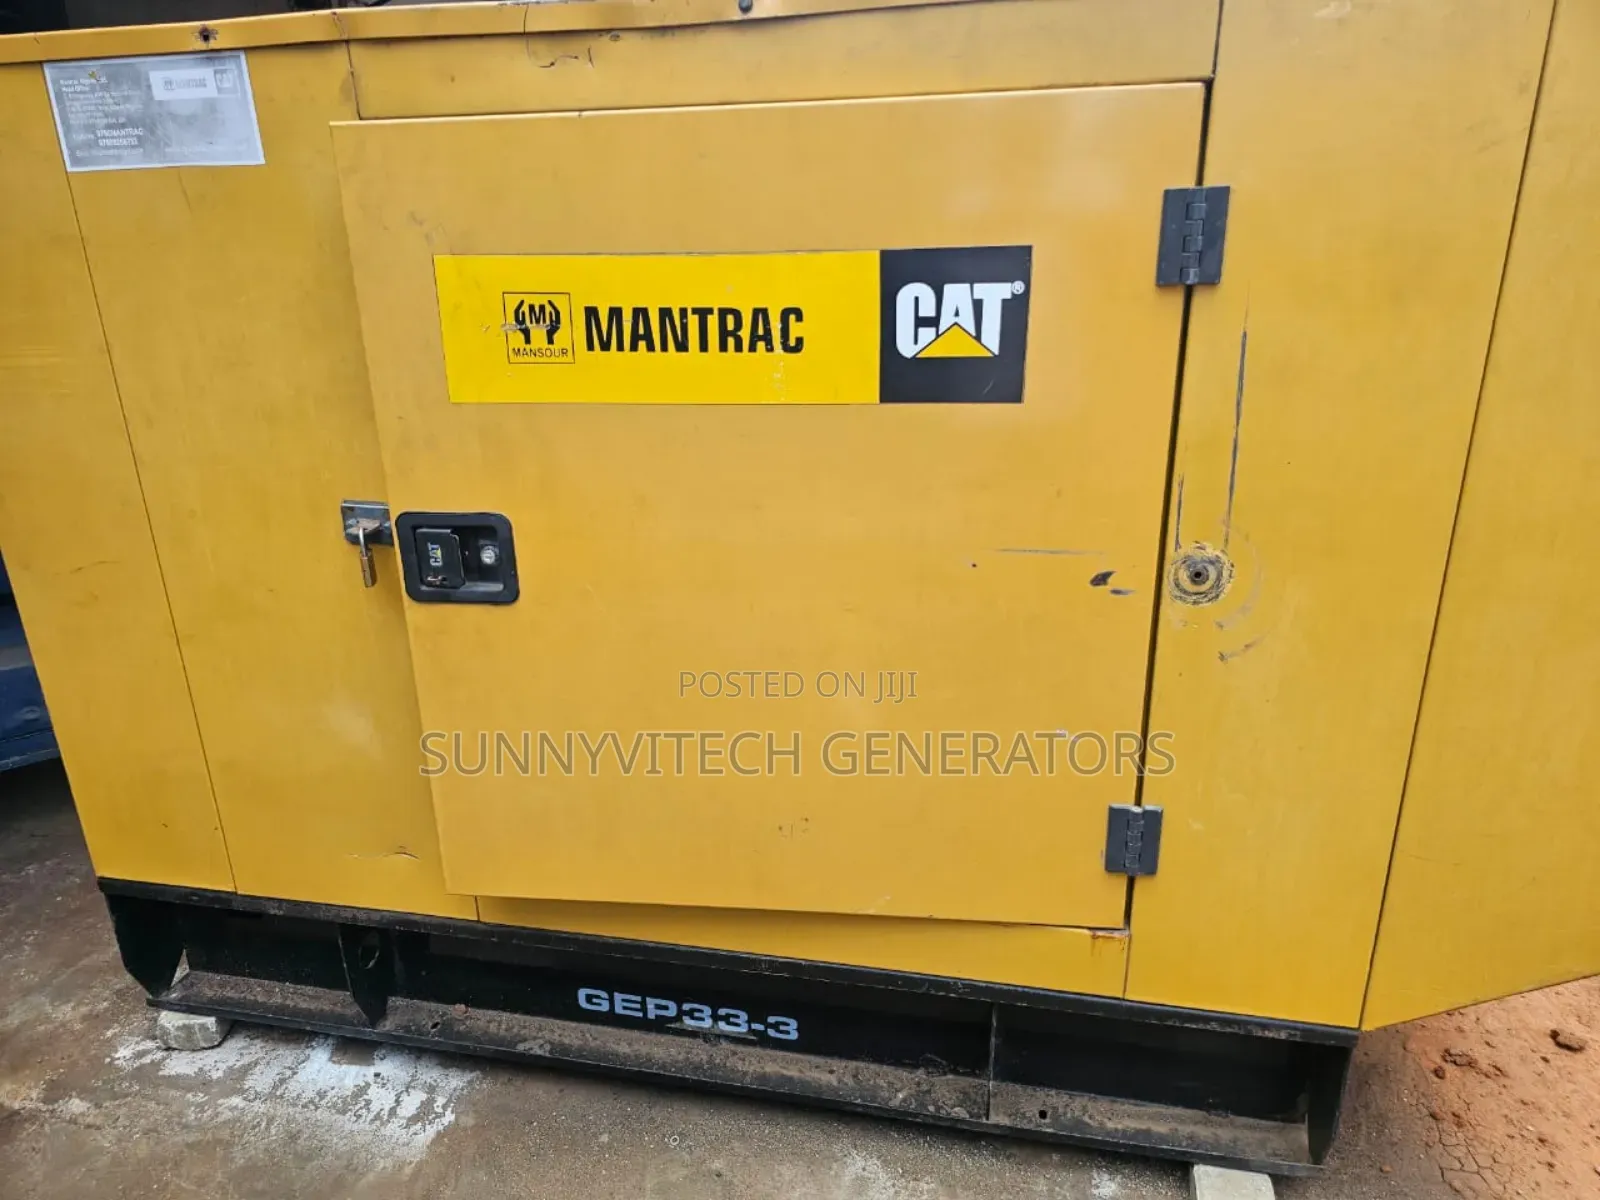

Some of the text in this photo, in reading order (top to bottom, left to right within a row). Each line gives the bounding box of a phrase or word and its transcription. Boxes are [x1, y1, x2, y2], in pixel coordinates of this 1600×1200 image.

[512, 347, 569, 358] MANSOUR
[584, 306, 804, 354] MANTRAC
[576, 987, 799, 1041] GEP33-3
